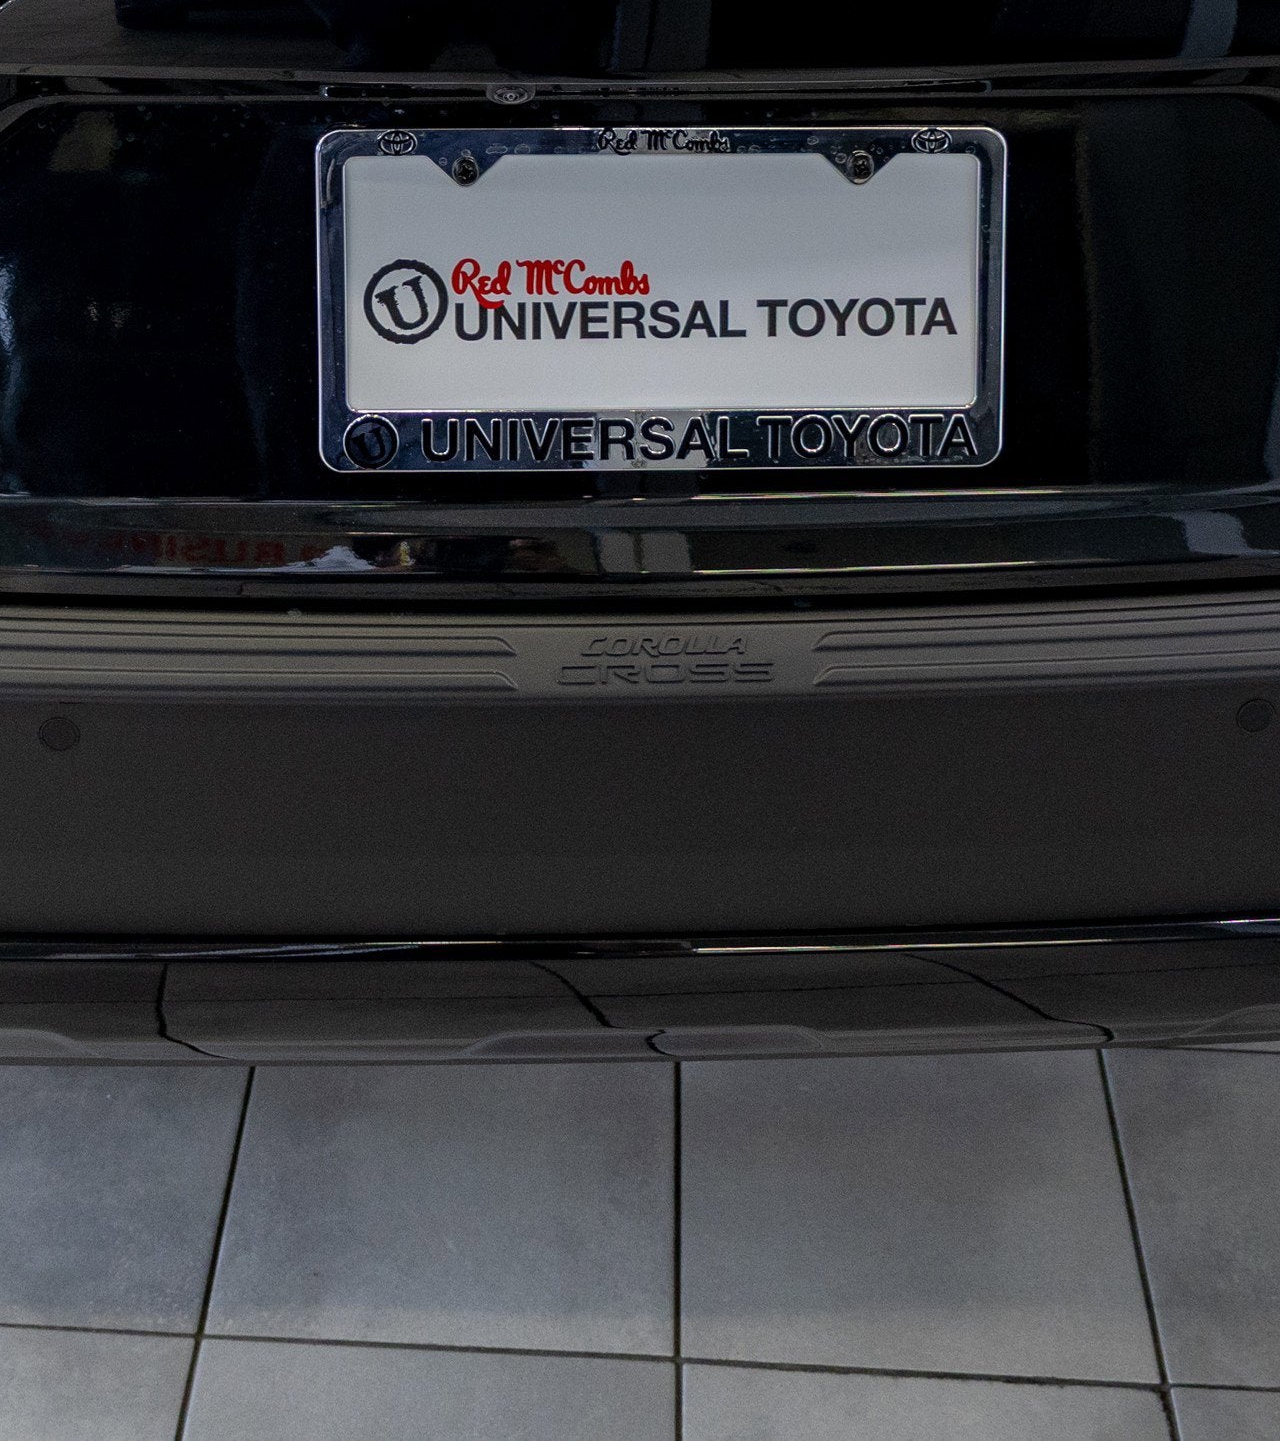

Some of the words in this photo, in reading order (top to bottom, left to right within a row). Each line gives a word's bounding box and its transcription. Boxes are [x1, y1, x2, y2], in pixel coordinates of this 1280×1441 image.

[597, 127, 638, 155] Red
[640, 129, 731, 154] McCombs
[451, 258, 512, 309] Red
[516, 259, 650, 296] McCombs
[455, 299, 747, 341] UNIVERSAL
[756, 297, 958, 337] TOYOTA
[421, 416, 750, 462] UNIVERSAL
[756, 413, 978, 460] TOYOTA
[581, 635, 748, 658] COROLLA
[556, 661, 775, 686] CROSS
